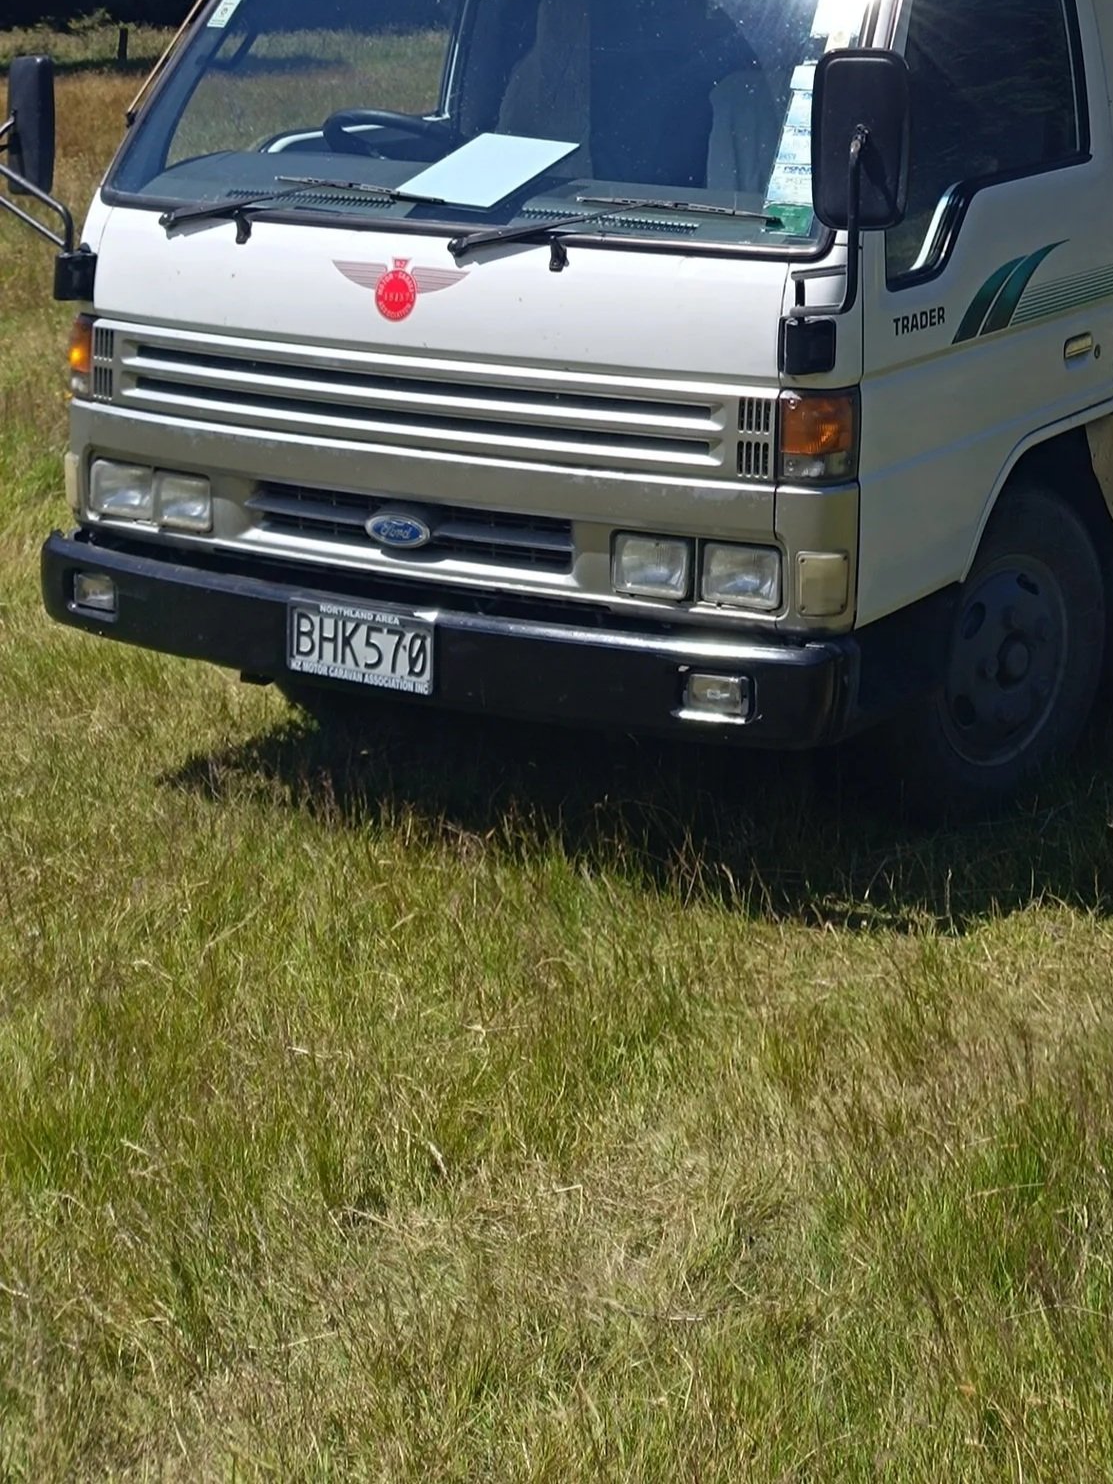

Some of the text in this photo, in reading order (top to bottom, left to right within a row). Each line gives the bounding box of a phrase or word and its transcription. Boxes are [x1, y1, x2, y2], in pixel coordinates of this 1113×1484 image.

[893, 306, 945, 336] TRADER
[379, 522, 412, 539] Ford
[319, 604, 400, 625] NORTHLAND AREA
[296, 611, 428, 678] BHK570
[301, 662, 329, 677] MOTOR
[328, 667, 363, 683] CARAVAN
[363, 673, 414, 692] ASSOCIATION
[414, 681, 430, 694] INC
